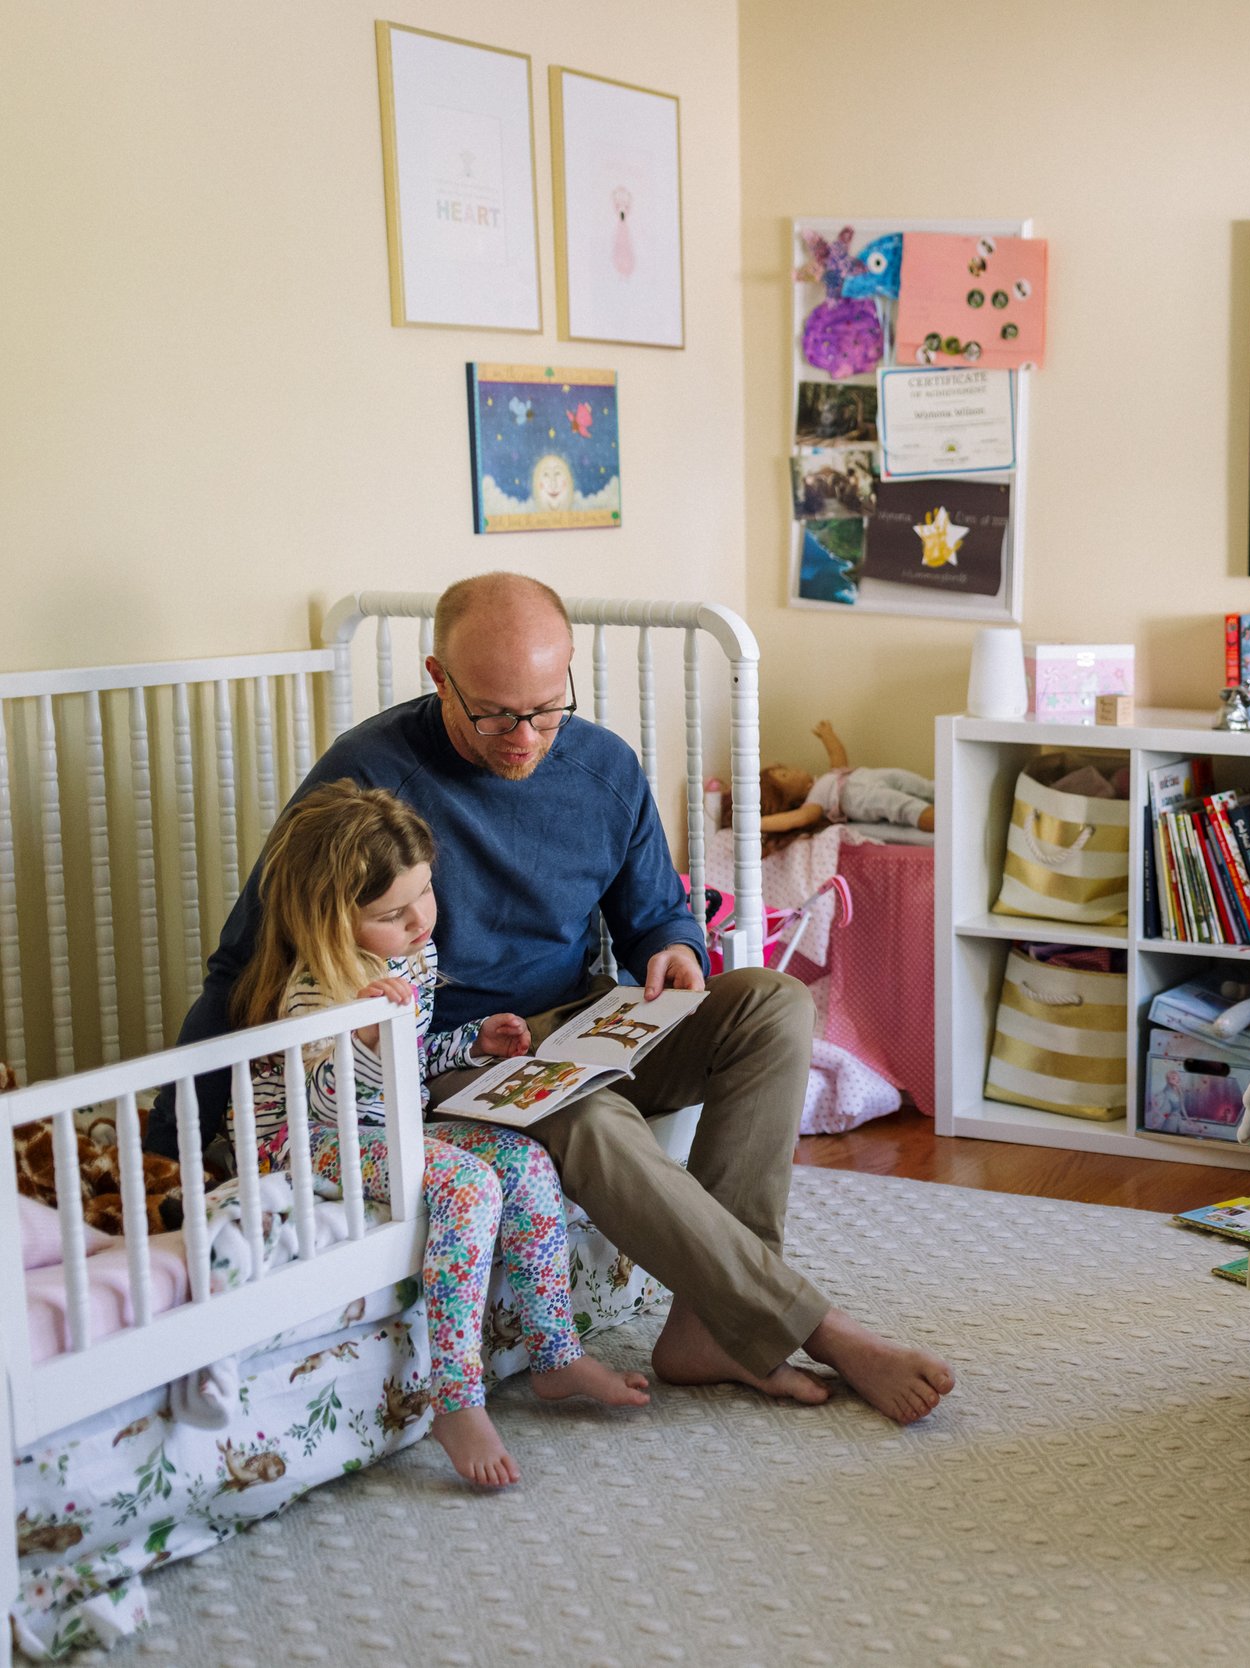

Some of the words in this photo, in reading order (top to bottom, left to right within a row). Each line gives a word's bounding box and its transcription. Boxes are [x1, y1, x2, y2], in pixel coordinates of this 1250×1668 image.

[436, 200, 501, 228] HEART
[908, 372, 988, 388] CERTIFICATE
[925, 386, 987, 397] ACHIEVEMENT
[1234, 818, 1246, 832] Good
